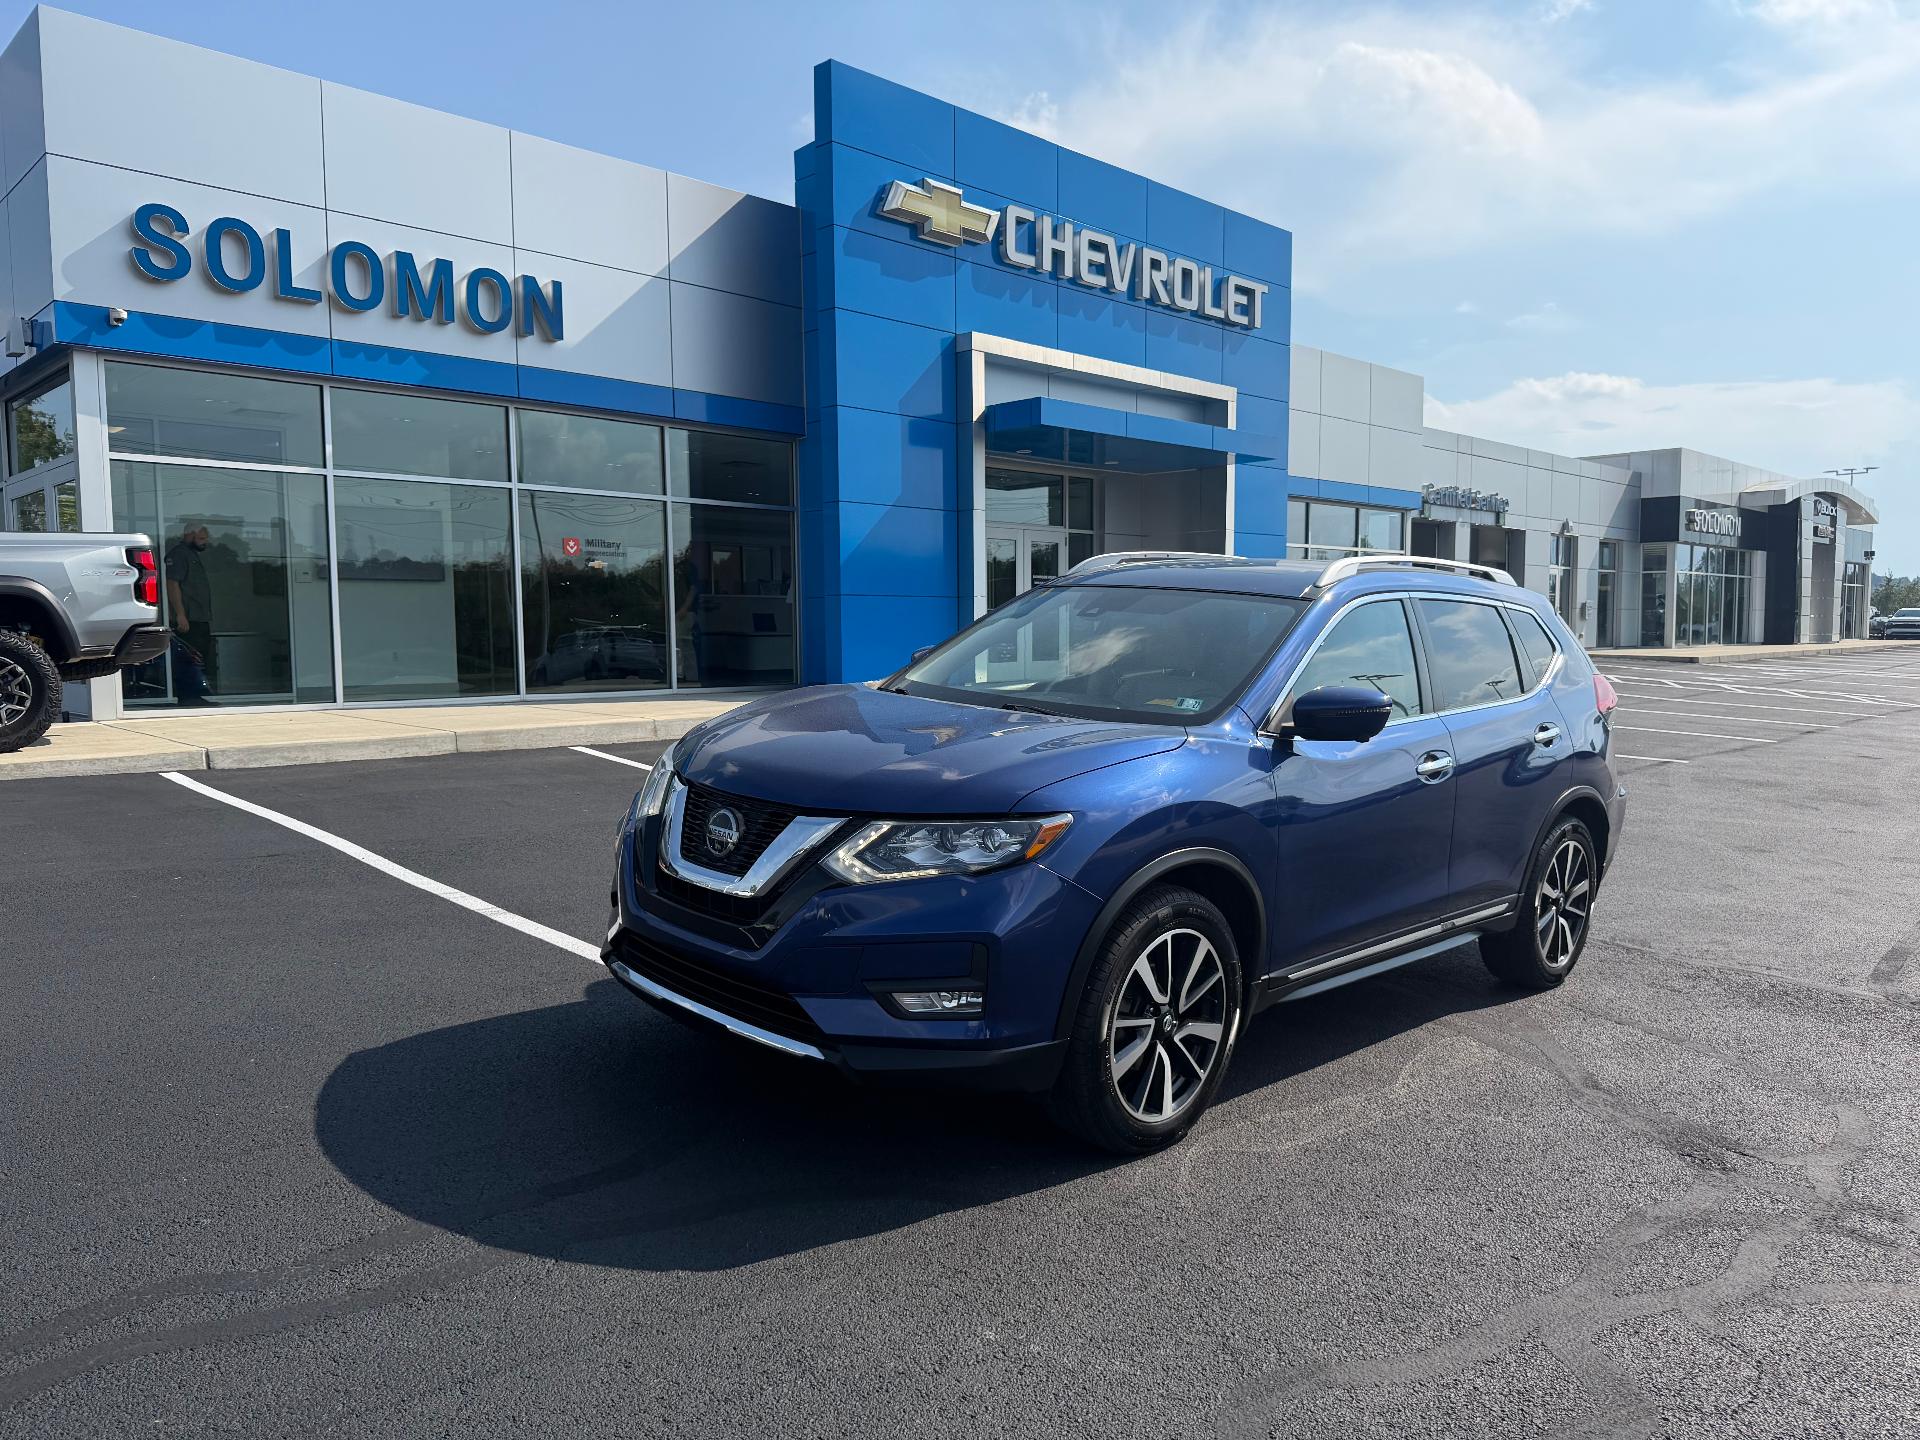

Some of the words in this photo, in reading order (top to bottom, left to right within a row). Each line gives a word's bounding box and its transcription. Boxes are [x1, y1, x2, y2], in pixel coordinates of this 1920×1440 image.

[128, 202, 564, 341] SOLOMON
[999, 204, 1268, 330] CHEVROLET
[1426, 486, 1472, 508] Certified
[1476, 492, 1509, 512] Service
[1694, 509, 1741, 536] SOLOMON
[585, 538, 622, 550] Military
